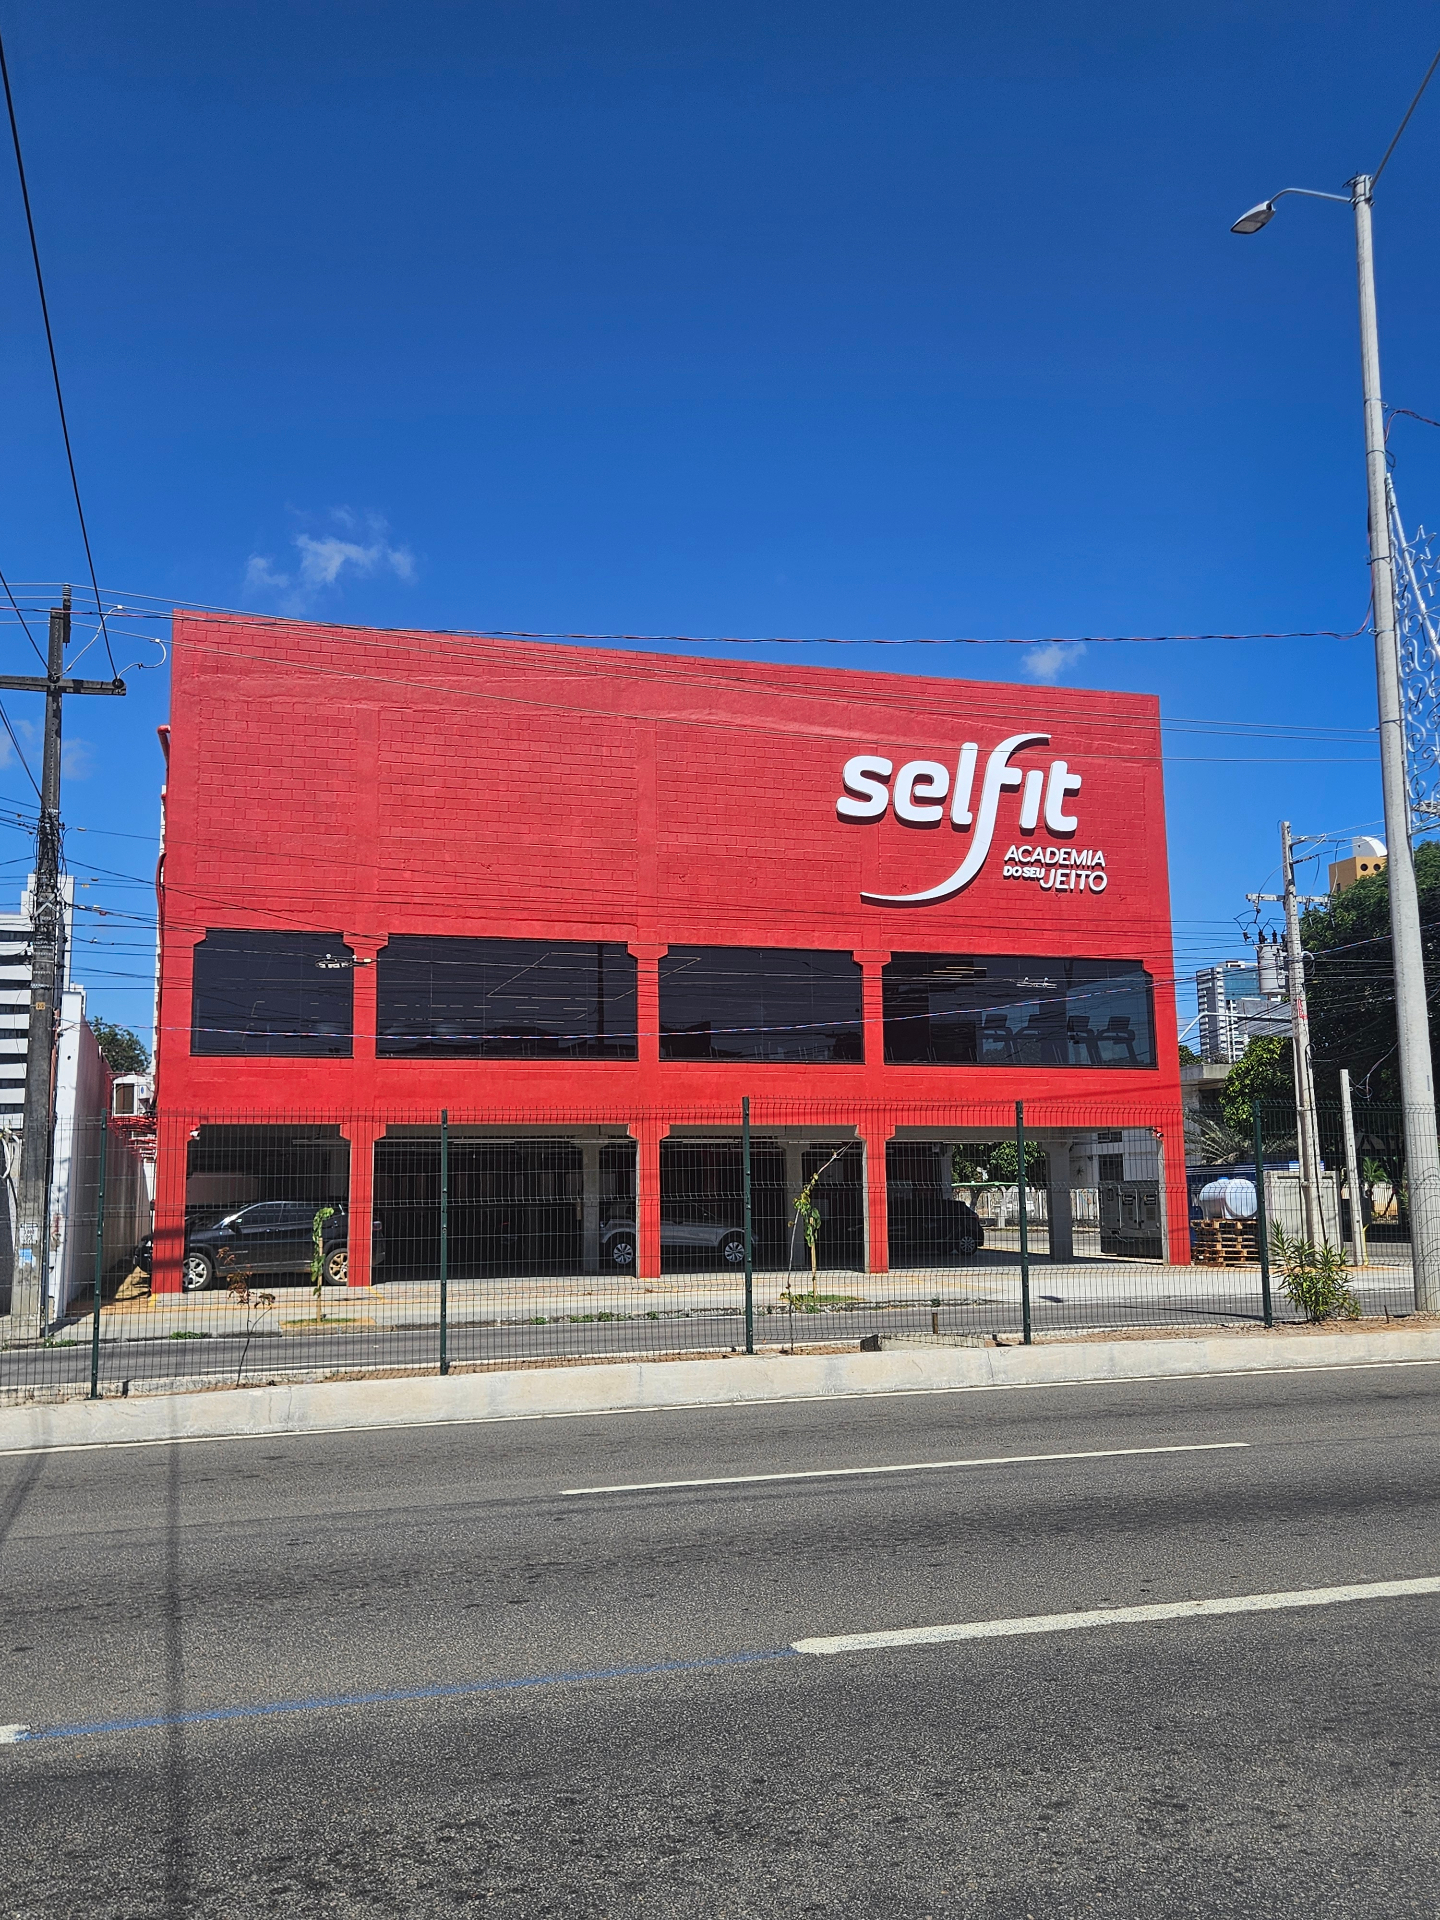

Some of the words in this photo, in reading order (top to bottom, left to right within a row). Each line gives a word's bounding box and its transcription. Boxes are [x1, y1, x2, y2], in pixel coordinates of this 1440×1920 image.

[836, 733, 1082, 901] selfit
[1004, 845, 1106, 868] ACADEMIA
[1040, 868, 1108, 891] JEITO
